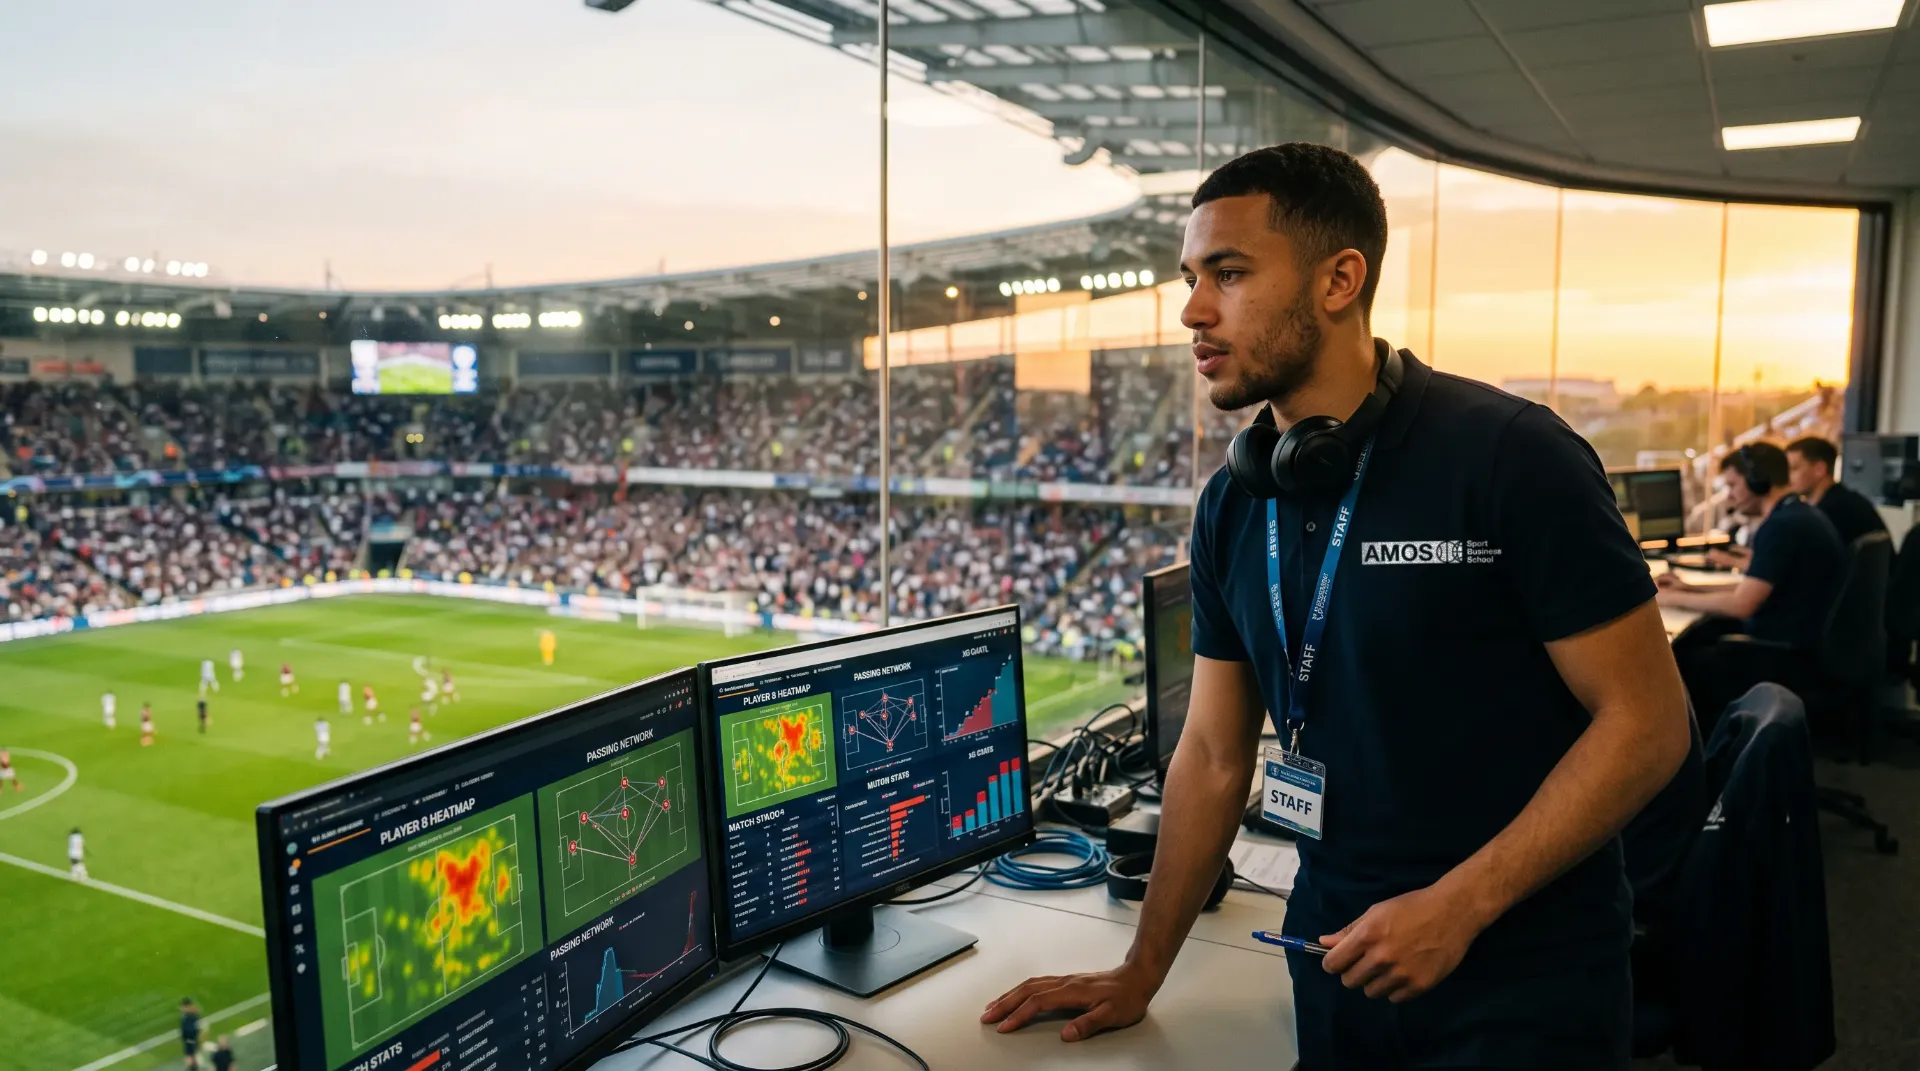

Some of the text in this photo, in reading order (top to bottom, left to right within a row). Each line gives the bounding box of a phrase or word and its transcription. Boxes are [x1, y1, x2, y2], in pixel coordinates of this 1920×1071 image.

[1331, 506, 1350, 547] STAFF
[1364, 543, 1433, 562] AMOS
[1466, 540, 1488, 548] Sport
[853, 668, 881, 682] PASSING
[882, 662, 911, 675] NETWORK
[1299, 643, 1316, 682] STAFF
[743, 692, 770, 706] PLAYER
[777, 684, 811, 699] HEATMAP
[586, 741, 619, 763] PASSING
[620, 728, 654, 750] NETWORK
[1271, 789, 1313, 816] STAFF
[380, 820, 420, 845] PLAYER
[421, 816, 428, 829] 8
[429, 798, 476, 826] HEATMAP
[728, 817, 755, 833] MATCH
[550, 936, 581, 961] PASSING
[581, 916, 615, 942] NETWORK
[370, 1041, 403, 1069] STATS
